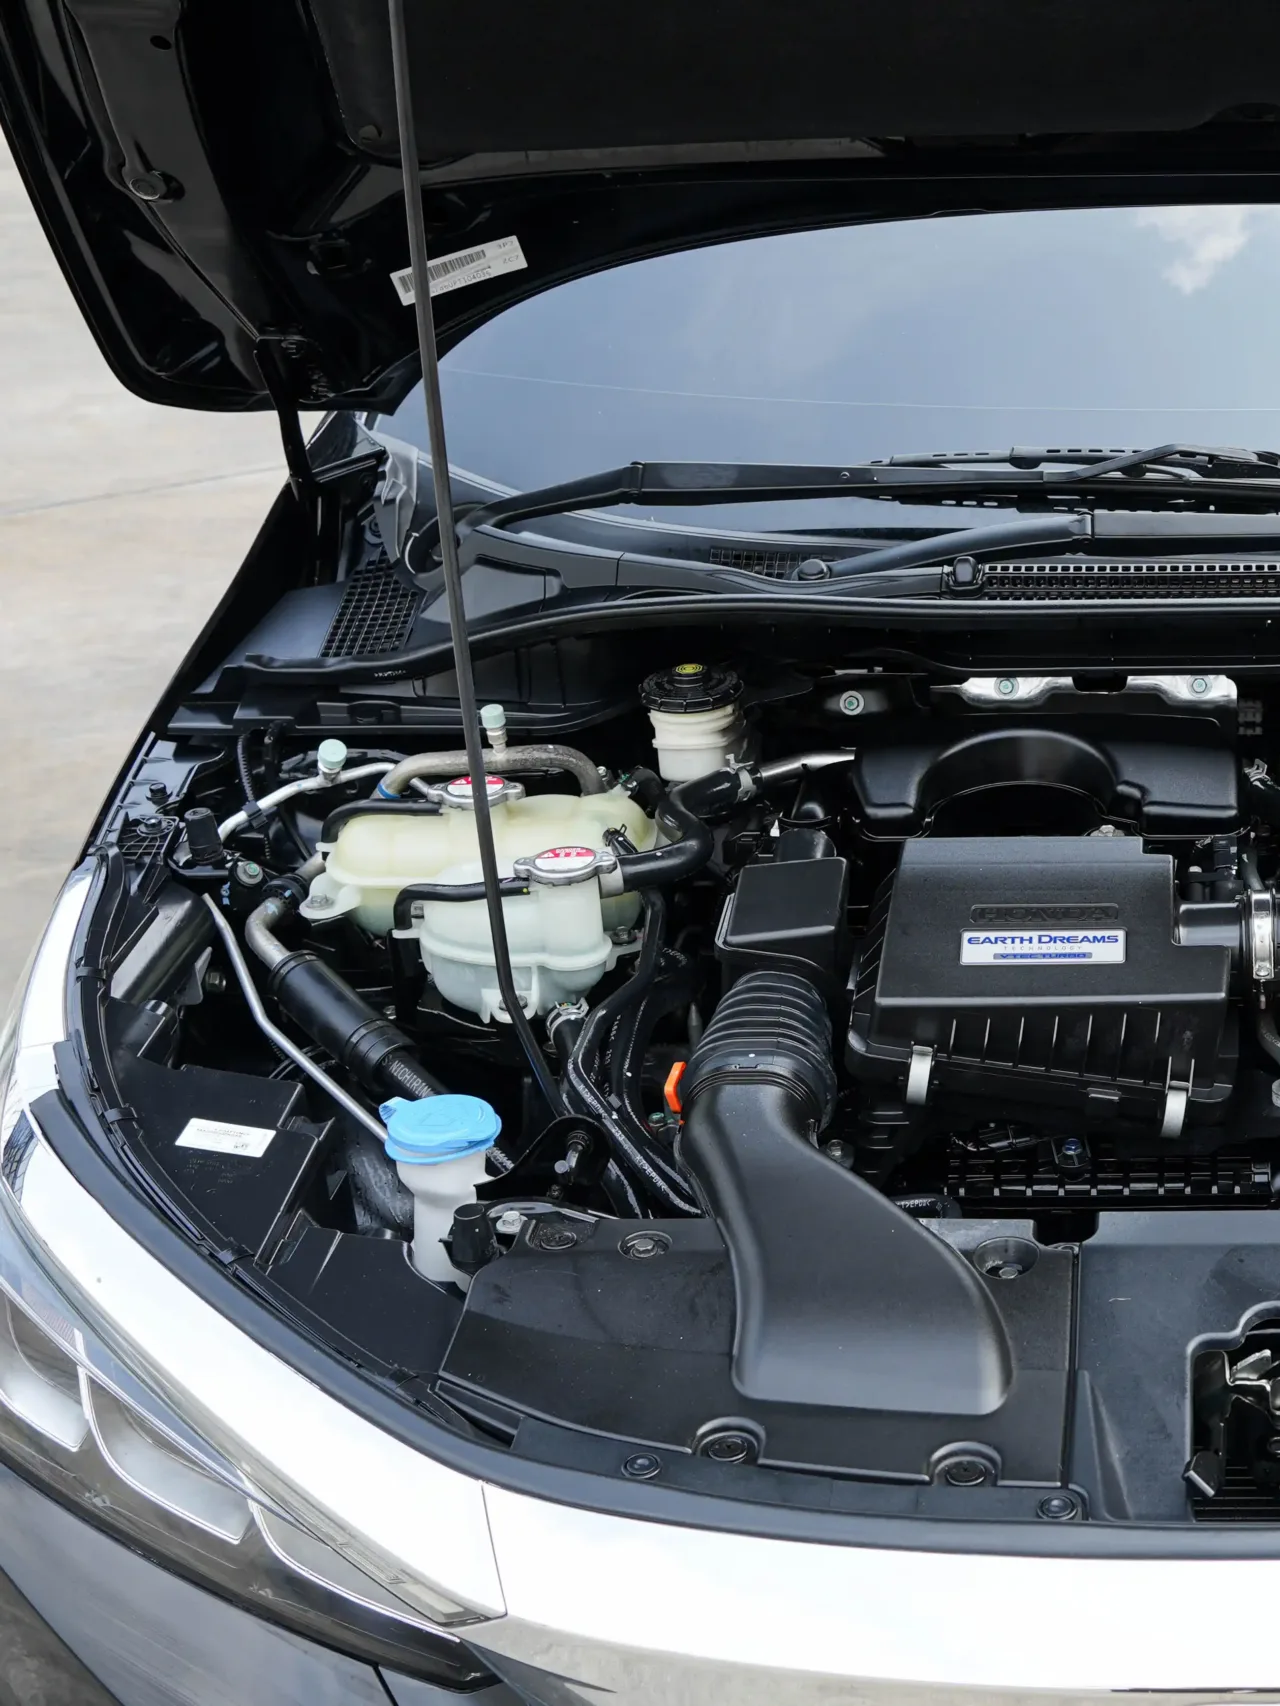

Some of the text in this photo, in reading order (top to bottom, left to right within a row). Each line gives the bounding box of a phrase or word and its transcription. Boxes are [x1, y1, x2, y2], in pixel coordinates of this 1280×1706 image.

[978, 906, 1112, 922] HONDA
[967, 934, 1119, 945] EARTH DREAMS
